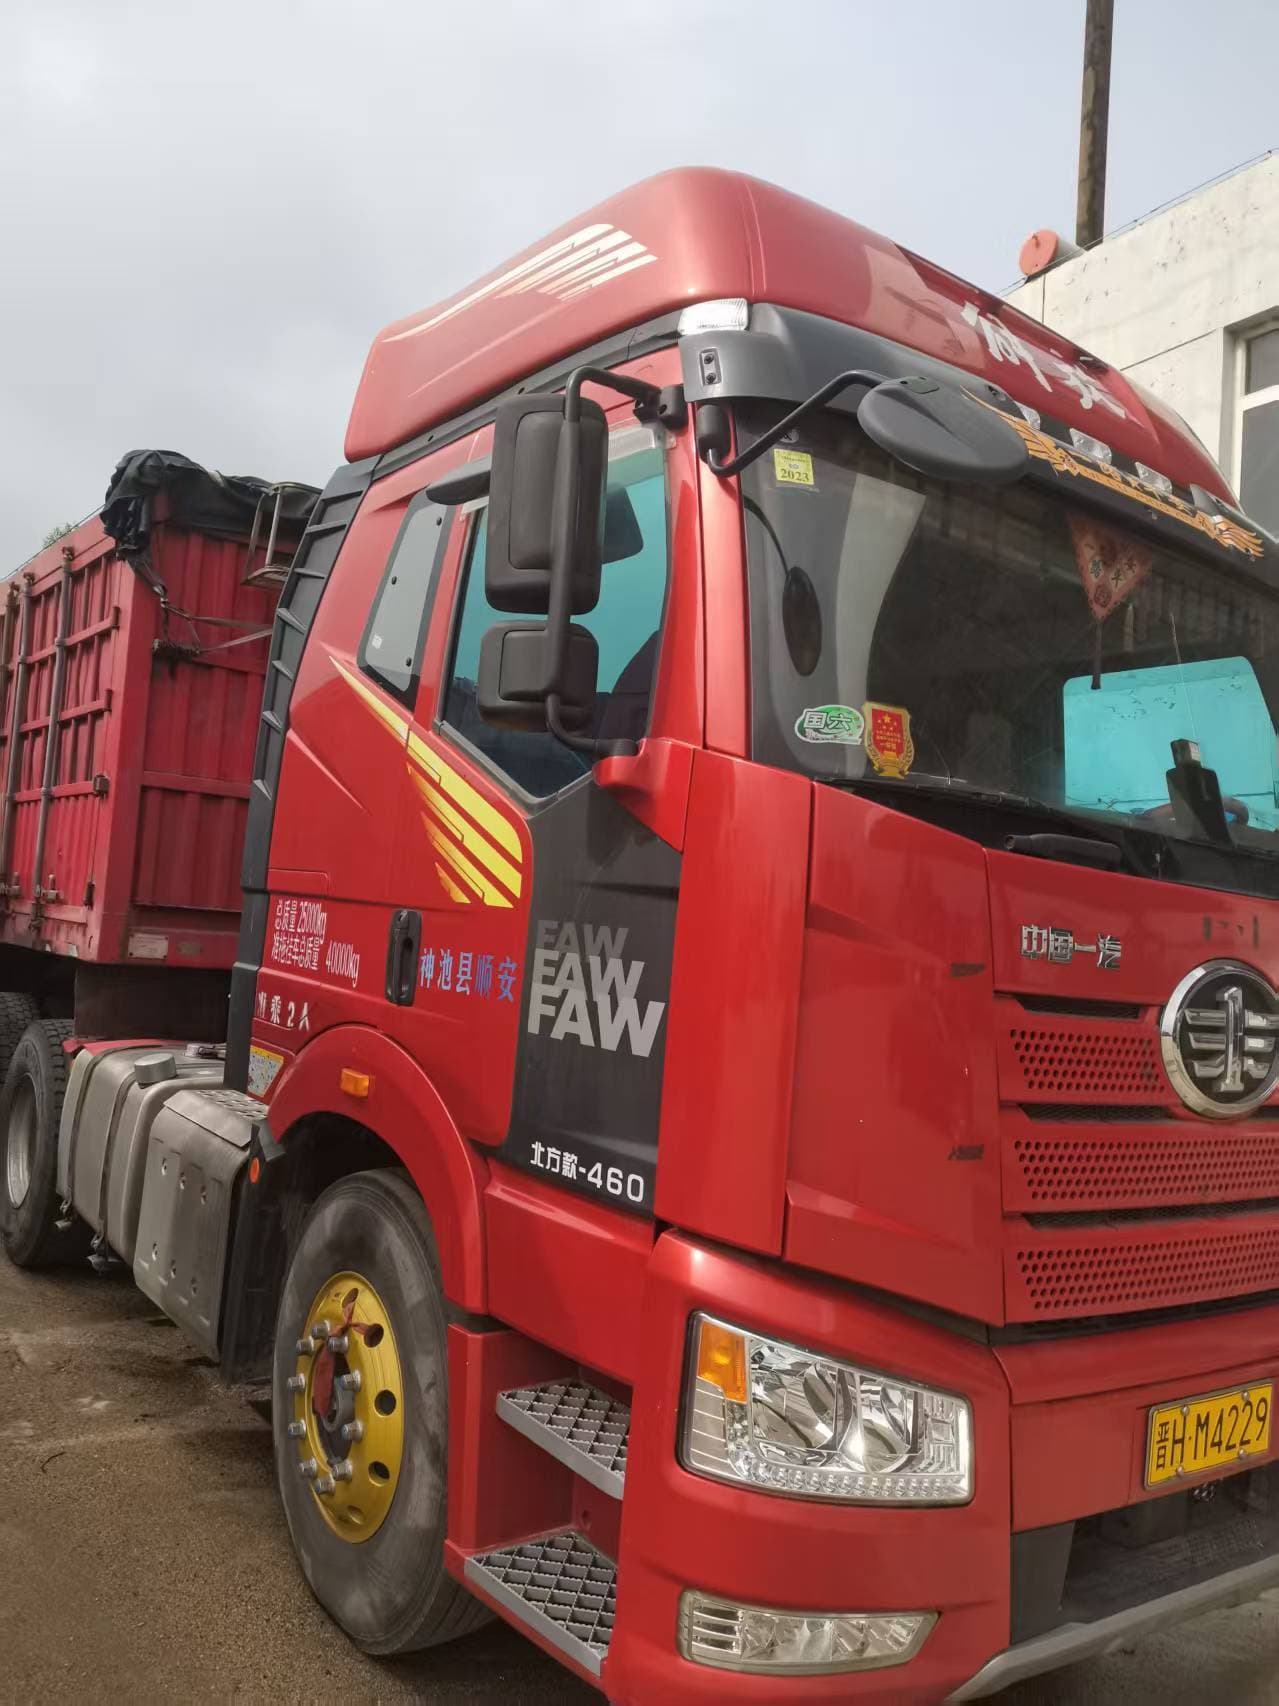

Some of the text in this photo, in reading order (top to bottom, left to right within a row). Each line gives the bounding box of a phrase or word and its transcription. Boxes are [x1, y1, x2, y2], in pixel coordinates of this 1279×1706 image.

[780, 468, 810, 483] 2023
[803, 710, 852, 731] 国六
[275, 899, 298, 932] 总质量
[537, 919, 629, 963] FAW
[1021, 924, 1121, 969] 中国一汽
[326, 940, 360, 988] 40000kg
[532, 948, 645, 1001] FAW
[527, 982, 665, 1058] FAW
